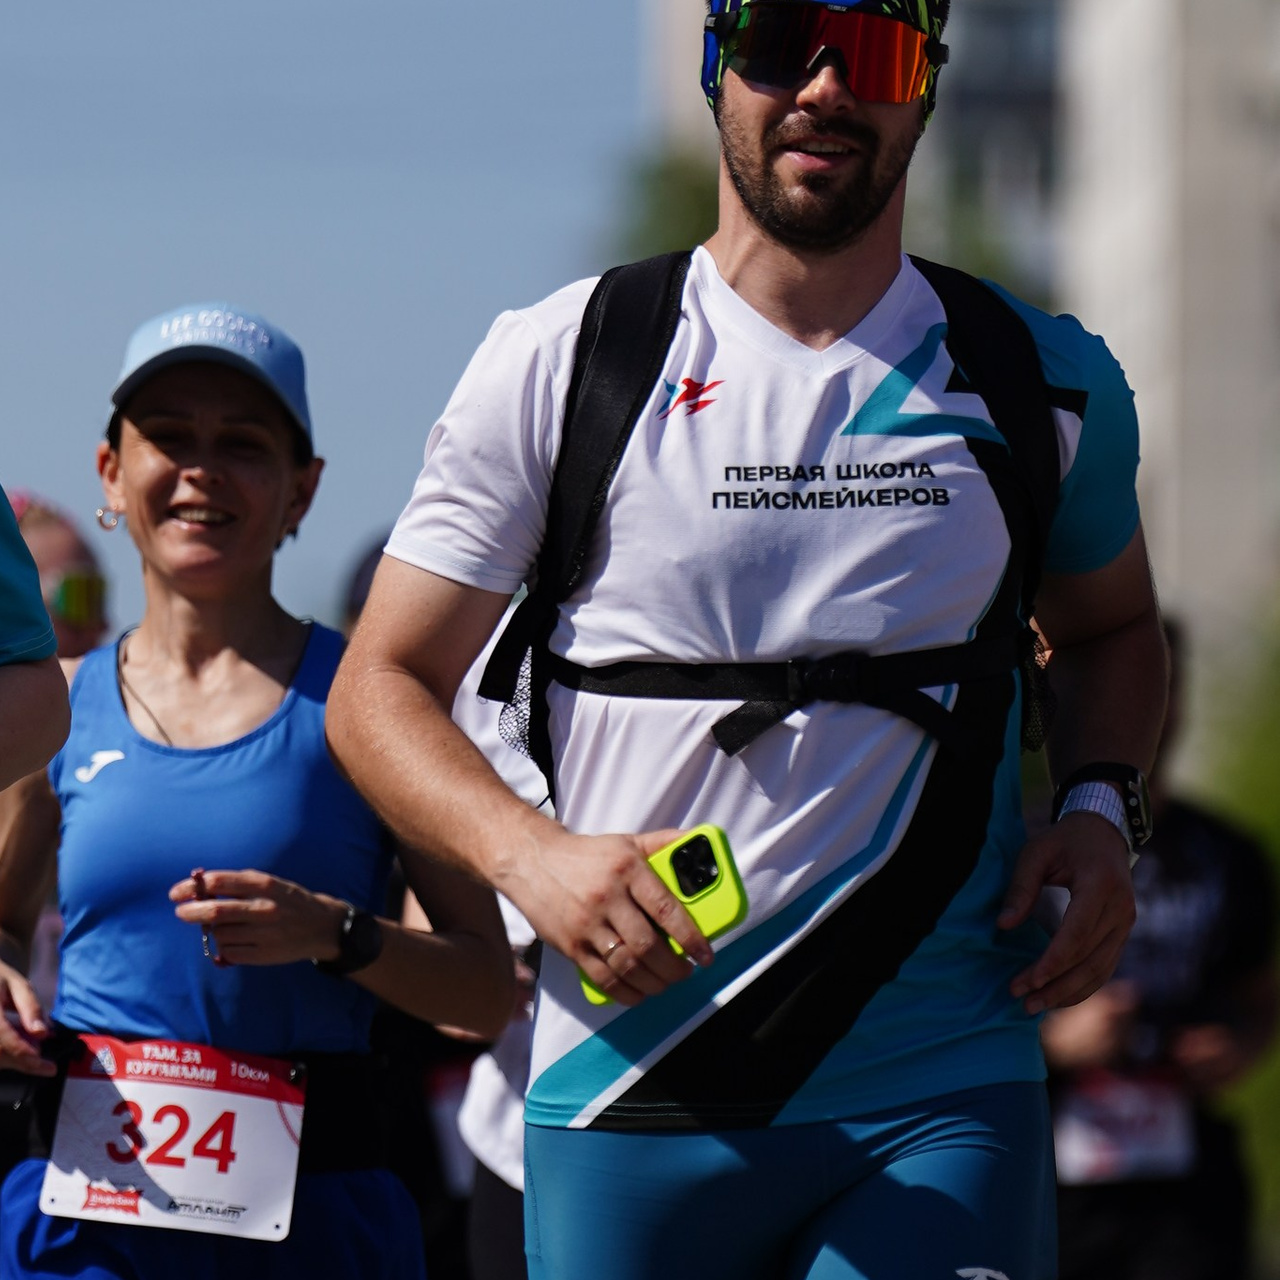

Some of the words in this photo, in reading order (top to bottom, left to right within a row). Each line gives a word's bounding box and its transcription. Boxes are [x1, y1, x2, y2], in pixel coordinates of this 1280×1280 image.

[725, 465, 825, 482] ПЕРВАЯ
[836, 462, 936, 481] ШКОЛА
[712, 487, 950, 510] ПЕЙСМЕЙКЕРОВ
[181, 1048, 202, 1065] ЗА
[105, 1100, 238, 1175] 324
